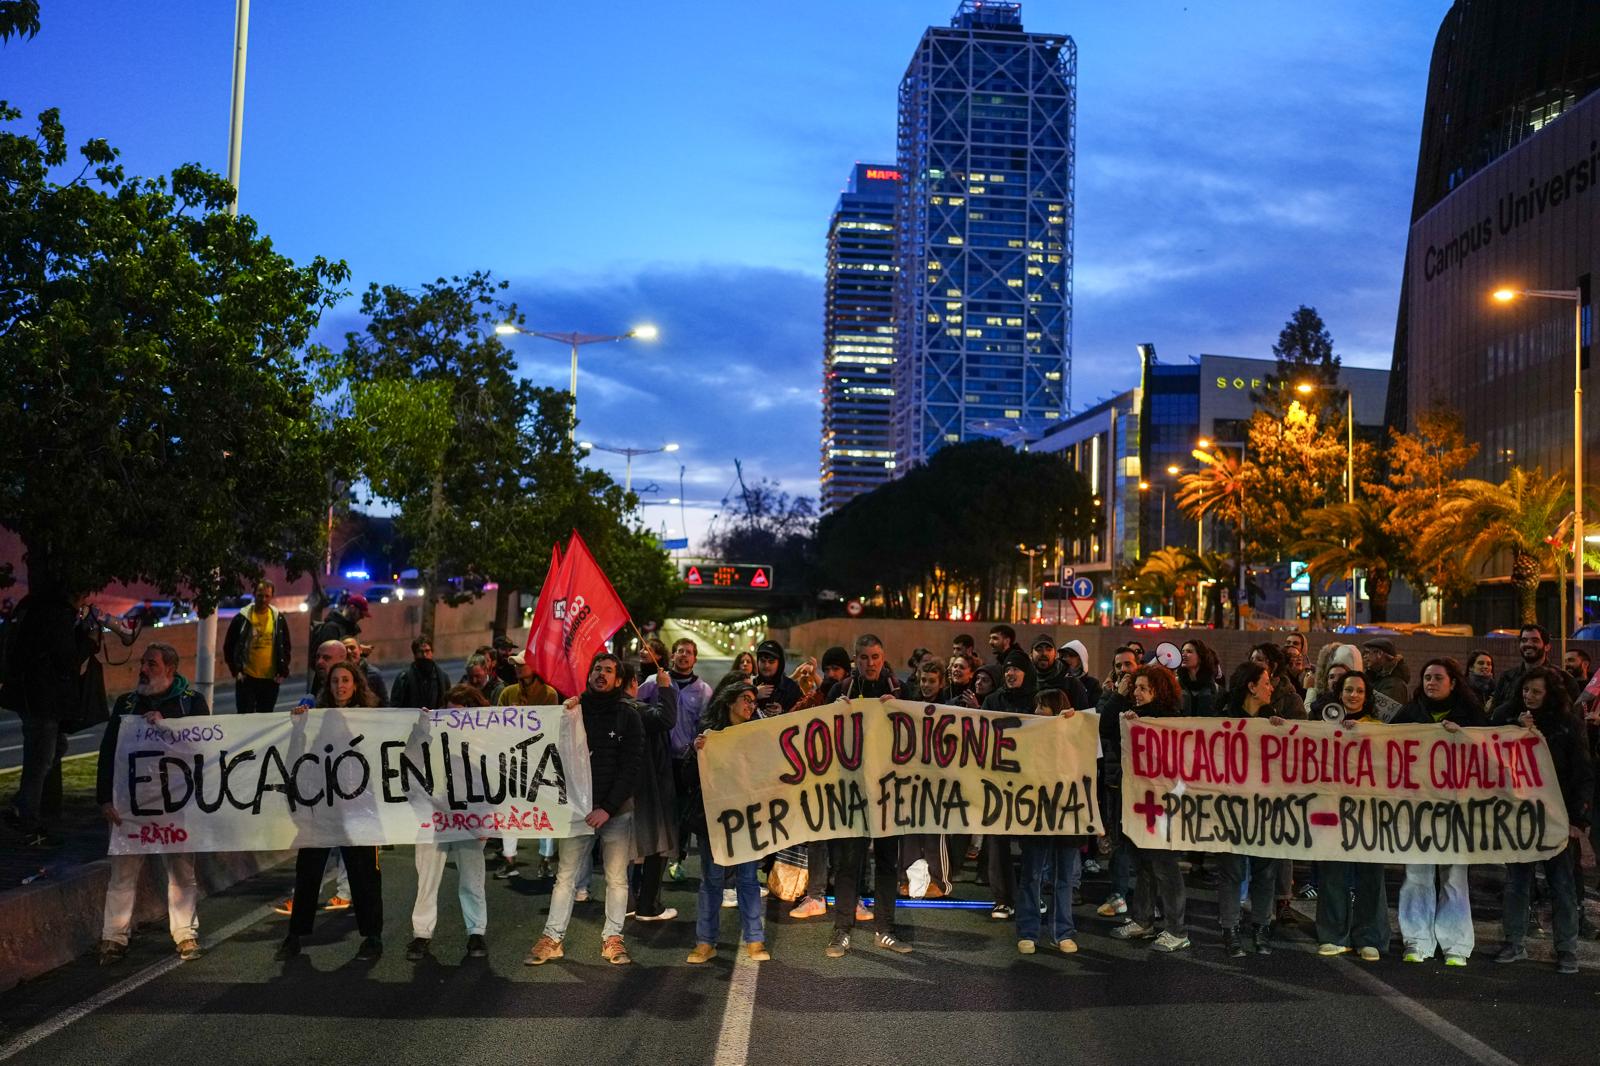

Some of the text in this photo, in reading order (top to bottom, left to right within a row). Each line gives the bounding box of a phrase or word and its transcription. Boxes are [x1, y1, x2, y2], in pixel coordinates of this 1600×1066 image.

[1424, 140, 1600, 282] Campus Universi
[381, 741, 435, 804] EN
[779, 711, 864, 785] SOU
[1387, 739, 1420, 790] DE
[717, 798, 789, 858] PER
[800, 779, 869, 834] UNA
